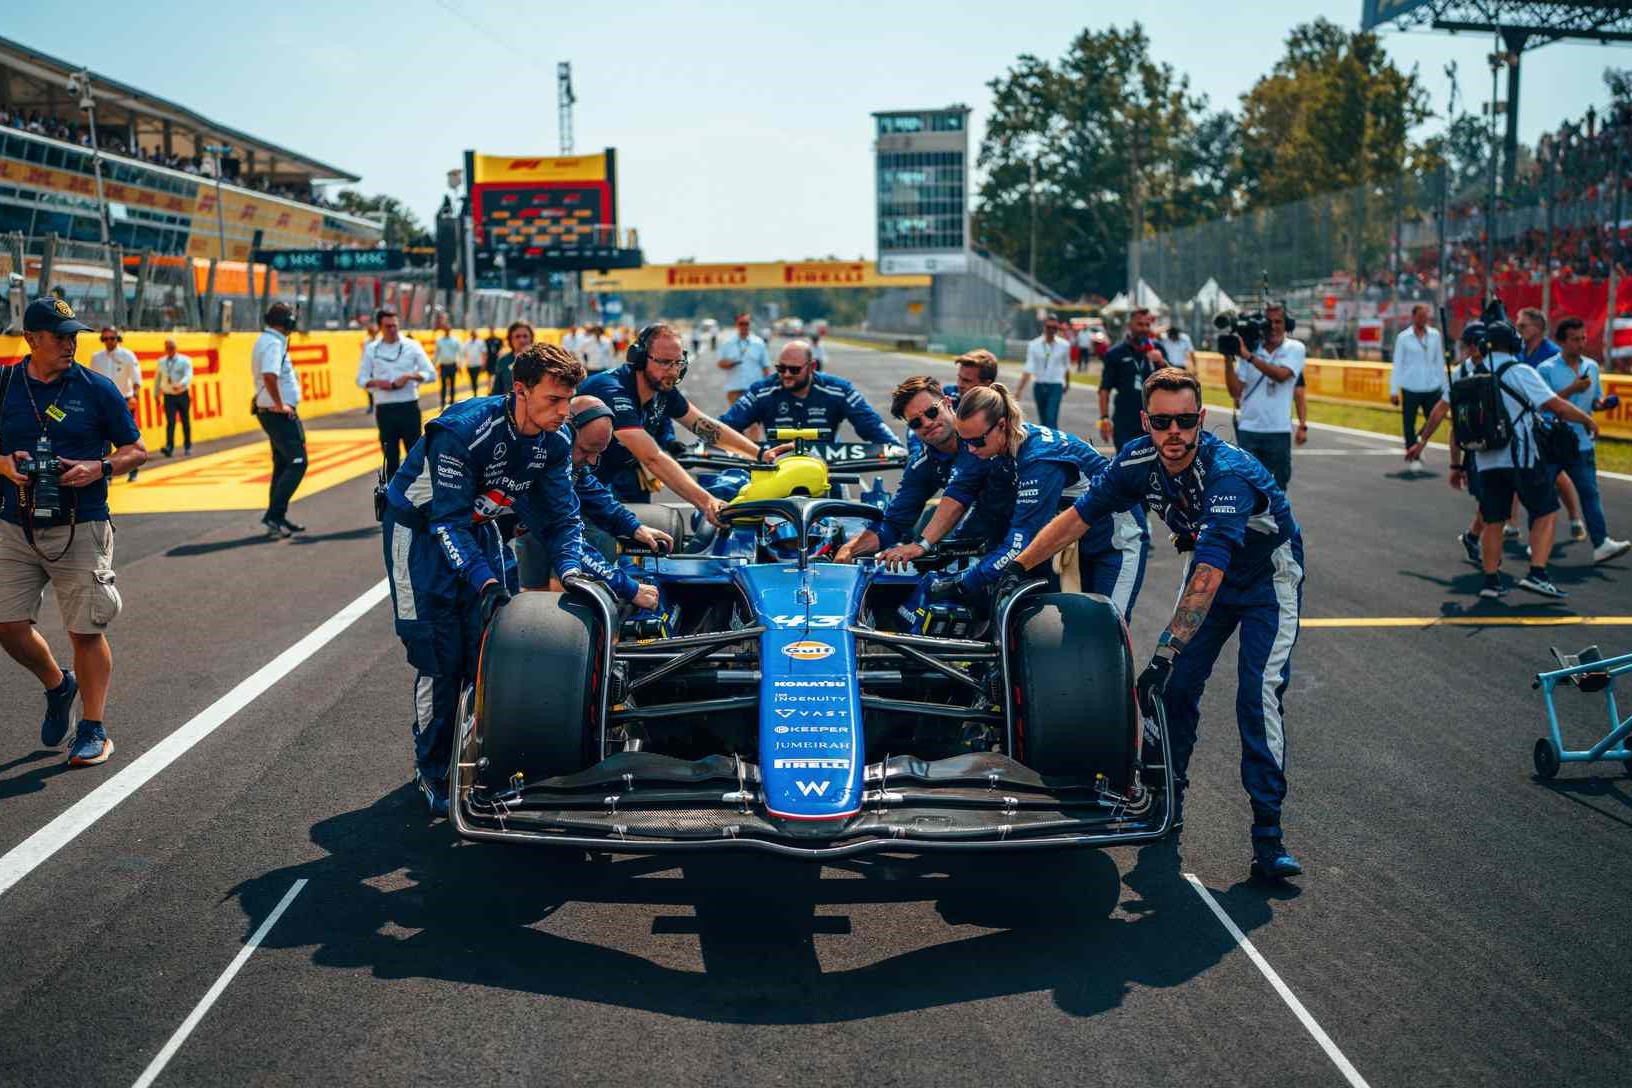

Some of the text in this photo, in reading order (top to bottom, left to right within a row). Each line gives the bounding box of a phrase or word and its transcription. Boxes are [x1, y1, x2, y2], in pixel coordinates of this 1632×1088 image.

[667, 265, 746, 286] PIRELLI
[785, 263, 863, 283] PIRELLI
[772, 615, 845, 627] 43
[785, 646, 830, 654] Gulf
[776, 741, 850, 750] JUMEIRAH
[773, 759, 850, 769] PIRELLI
